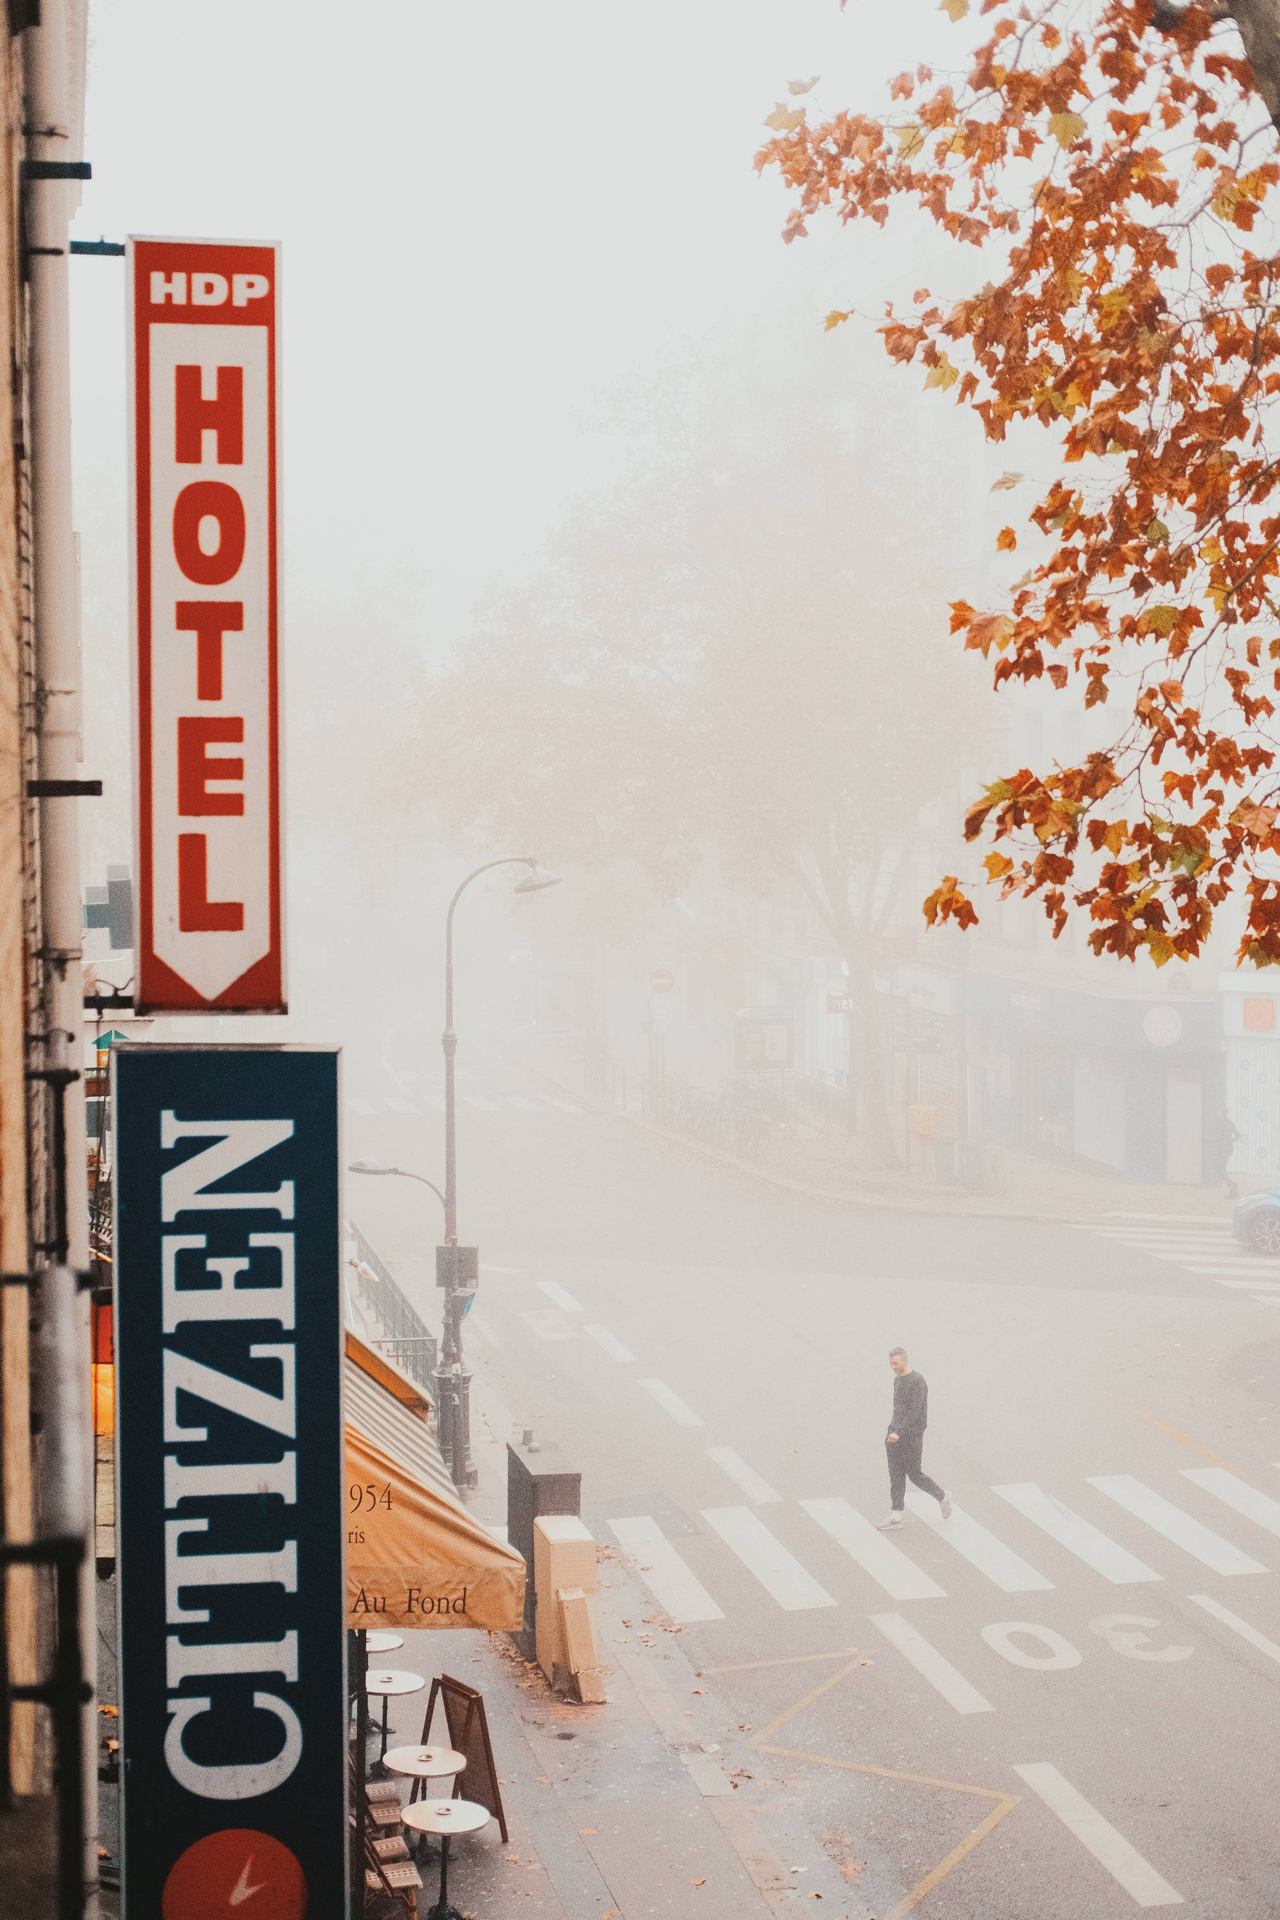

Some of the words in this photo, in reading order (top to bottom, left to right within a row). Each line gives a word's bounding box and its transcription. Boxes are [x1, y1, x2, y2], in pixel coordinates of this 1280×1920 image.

[150, 271, 269, 307] HDP
[172, 364, 246, 932] HOTEL
[160, 1109, 303, 1800] CITIZEN
[350, 1587, 387, 1614] Au
[405, 1587, 467, 1615] Fond
